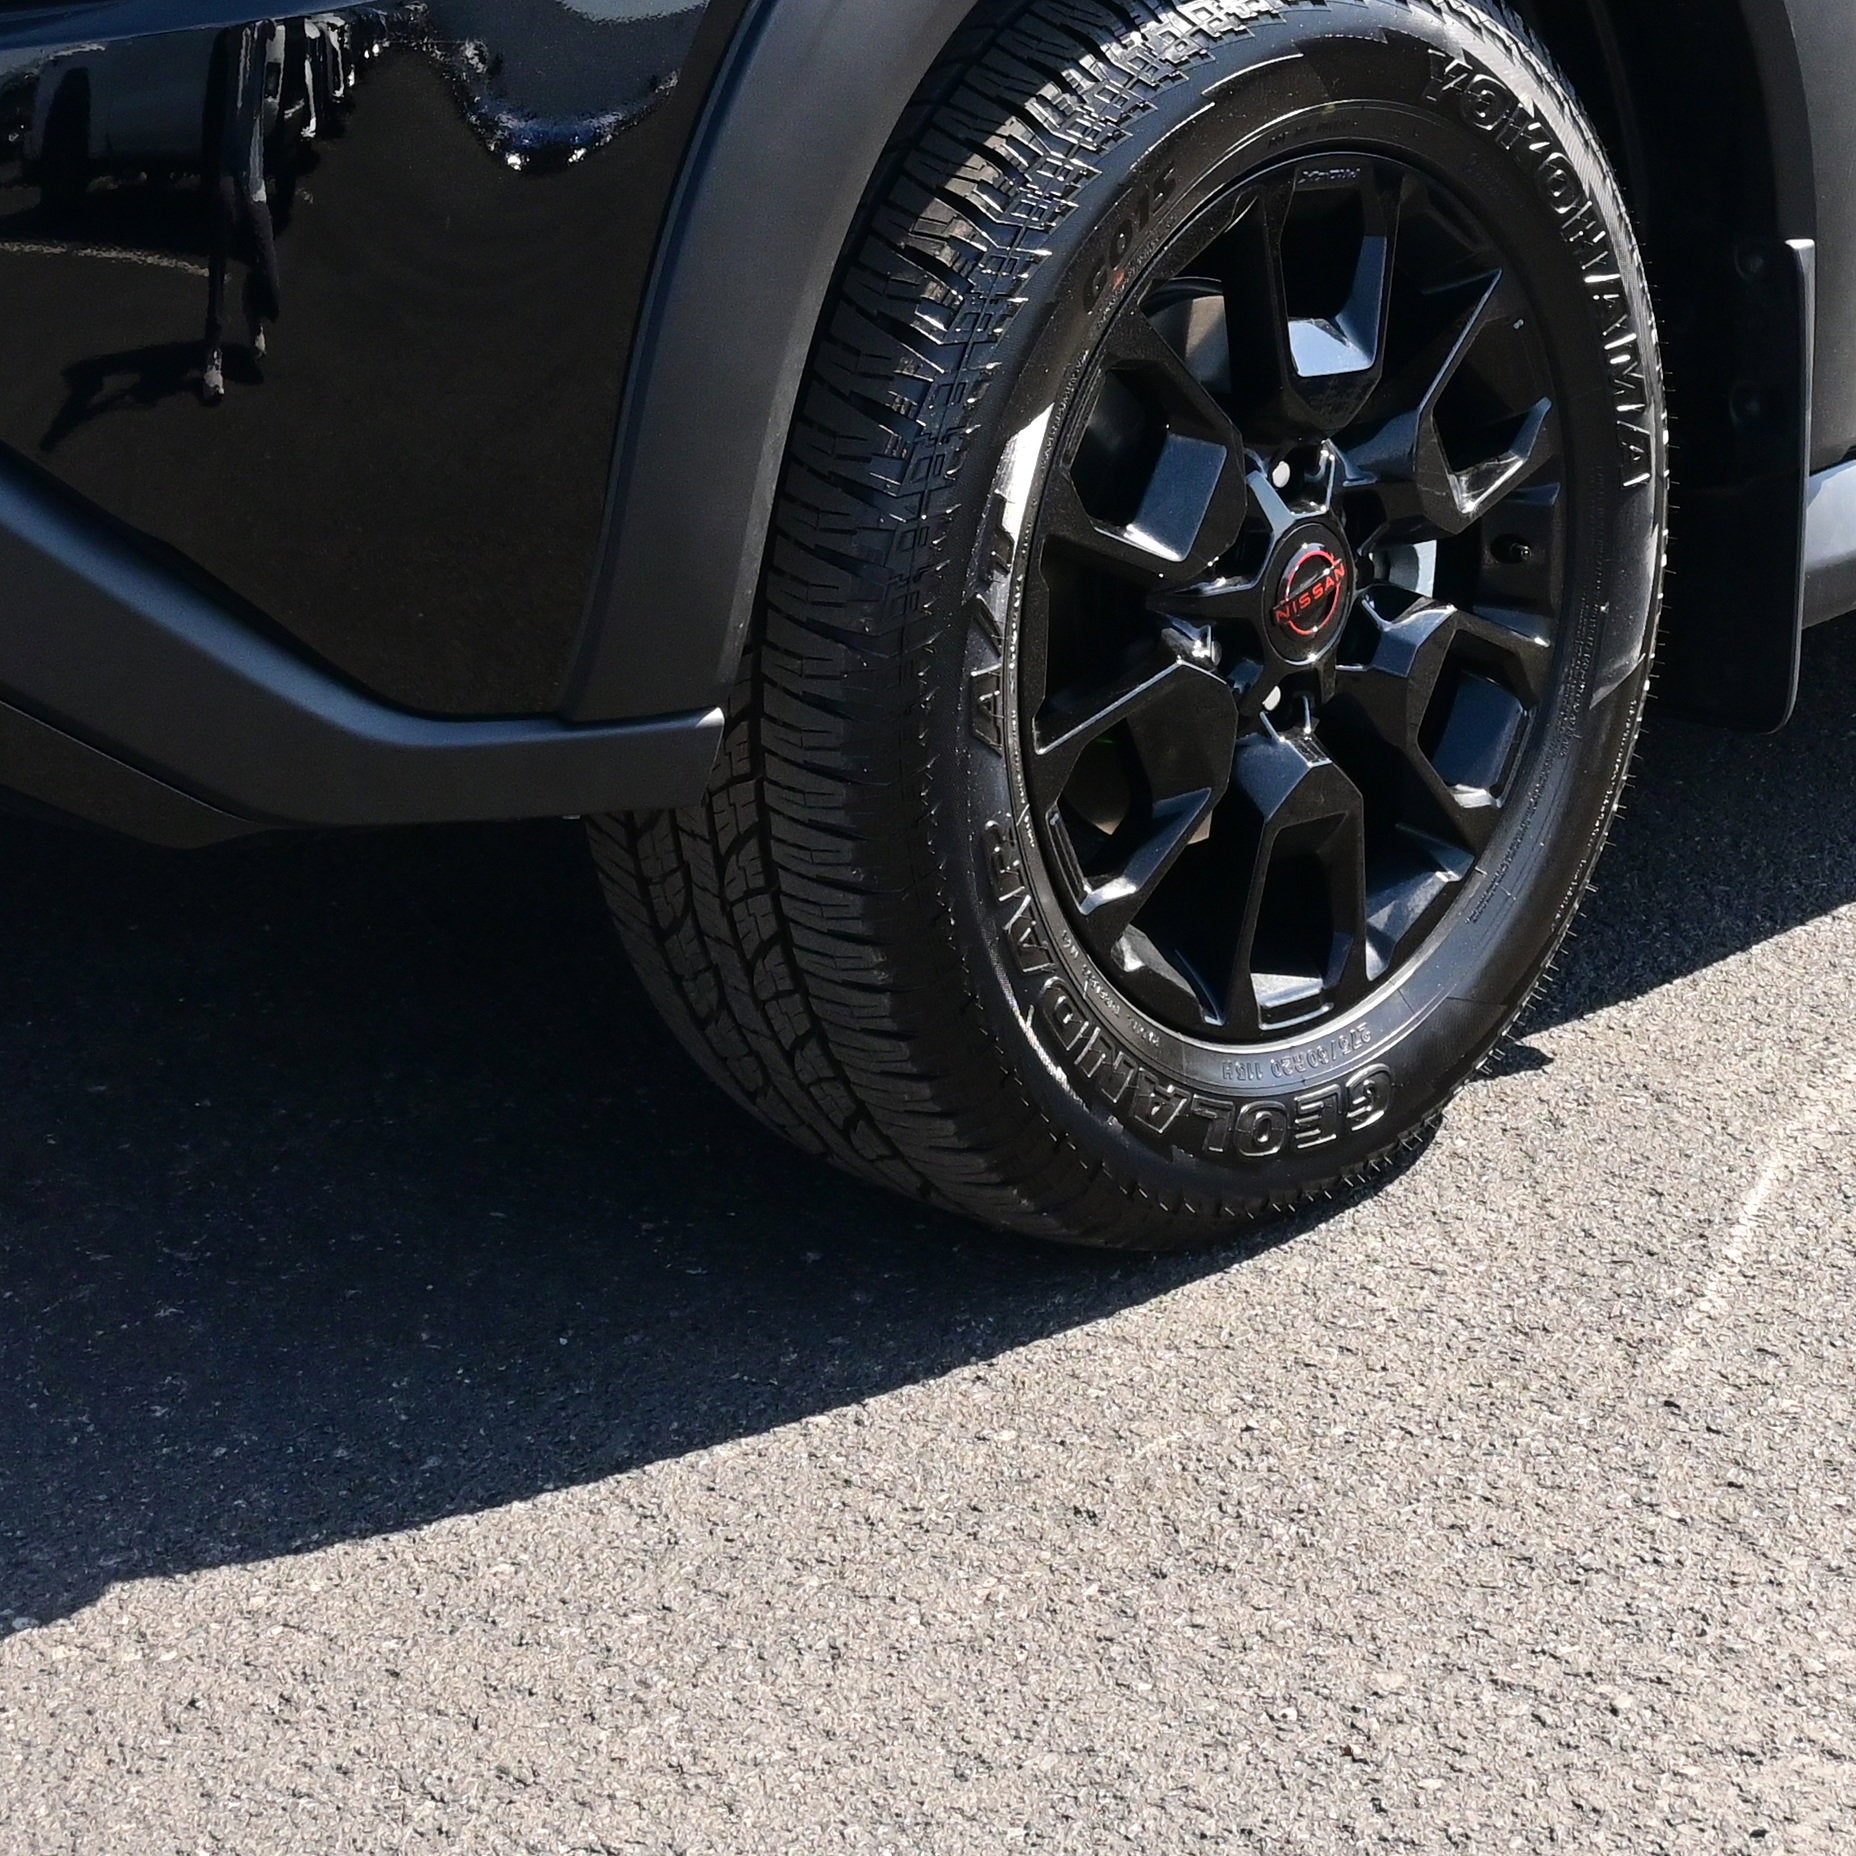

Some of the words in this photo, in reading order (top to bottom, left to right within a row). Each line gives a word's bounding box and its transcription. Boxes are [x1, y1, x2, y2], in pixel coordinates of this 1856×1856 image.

[1424, 47, 1652, 488] YOKOHAMA
[1275, 562, 1346, 624] NISSAN
[984, 819, 1394, 1157] GEOLANDAR
